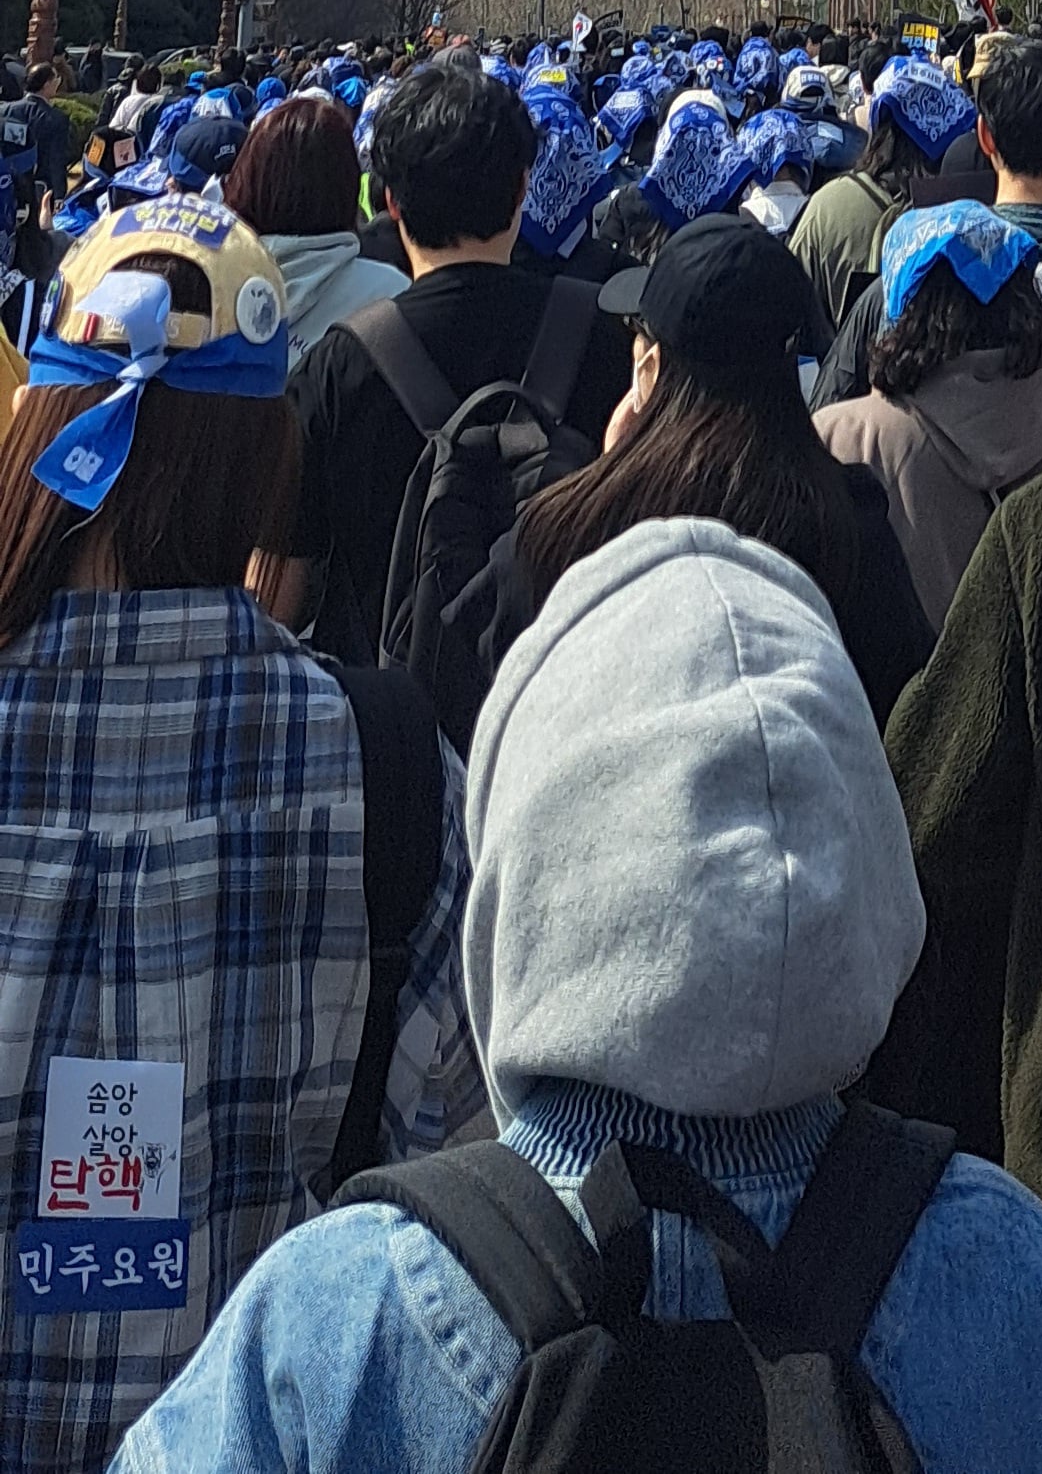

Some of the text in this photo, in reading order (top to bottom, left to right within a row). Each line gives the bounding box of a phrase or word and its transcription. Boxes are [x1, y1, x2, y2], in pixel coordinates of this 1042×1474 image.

[87, 1082, 138, 1116] 솜앙
[82, 1124, 138, 1158] 살앙
[47, 1153, 142, 1212] 탄핵
[18, 1238, 185, 1295] 민주요원
